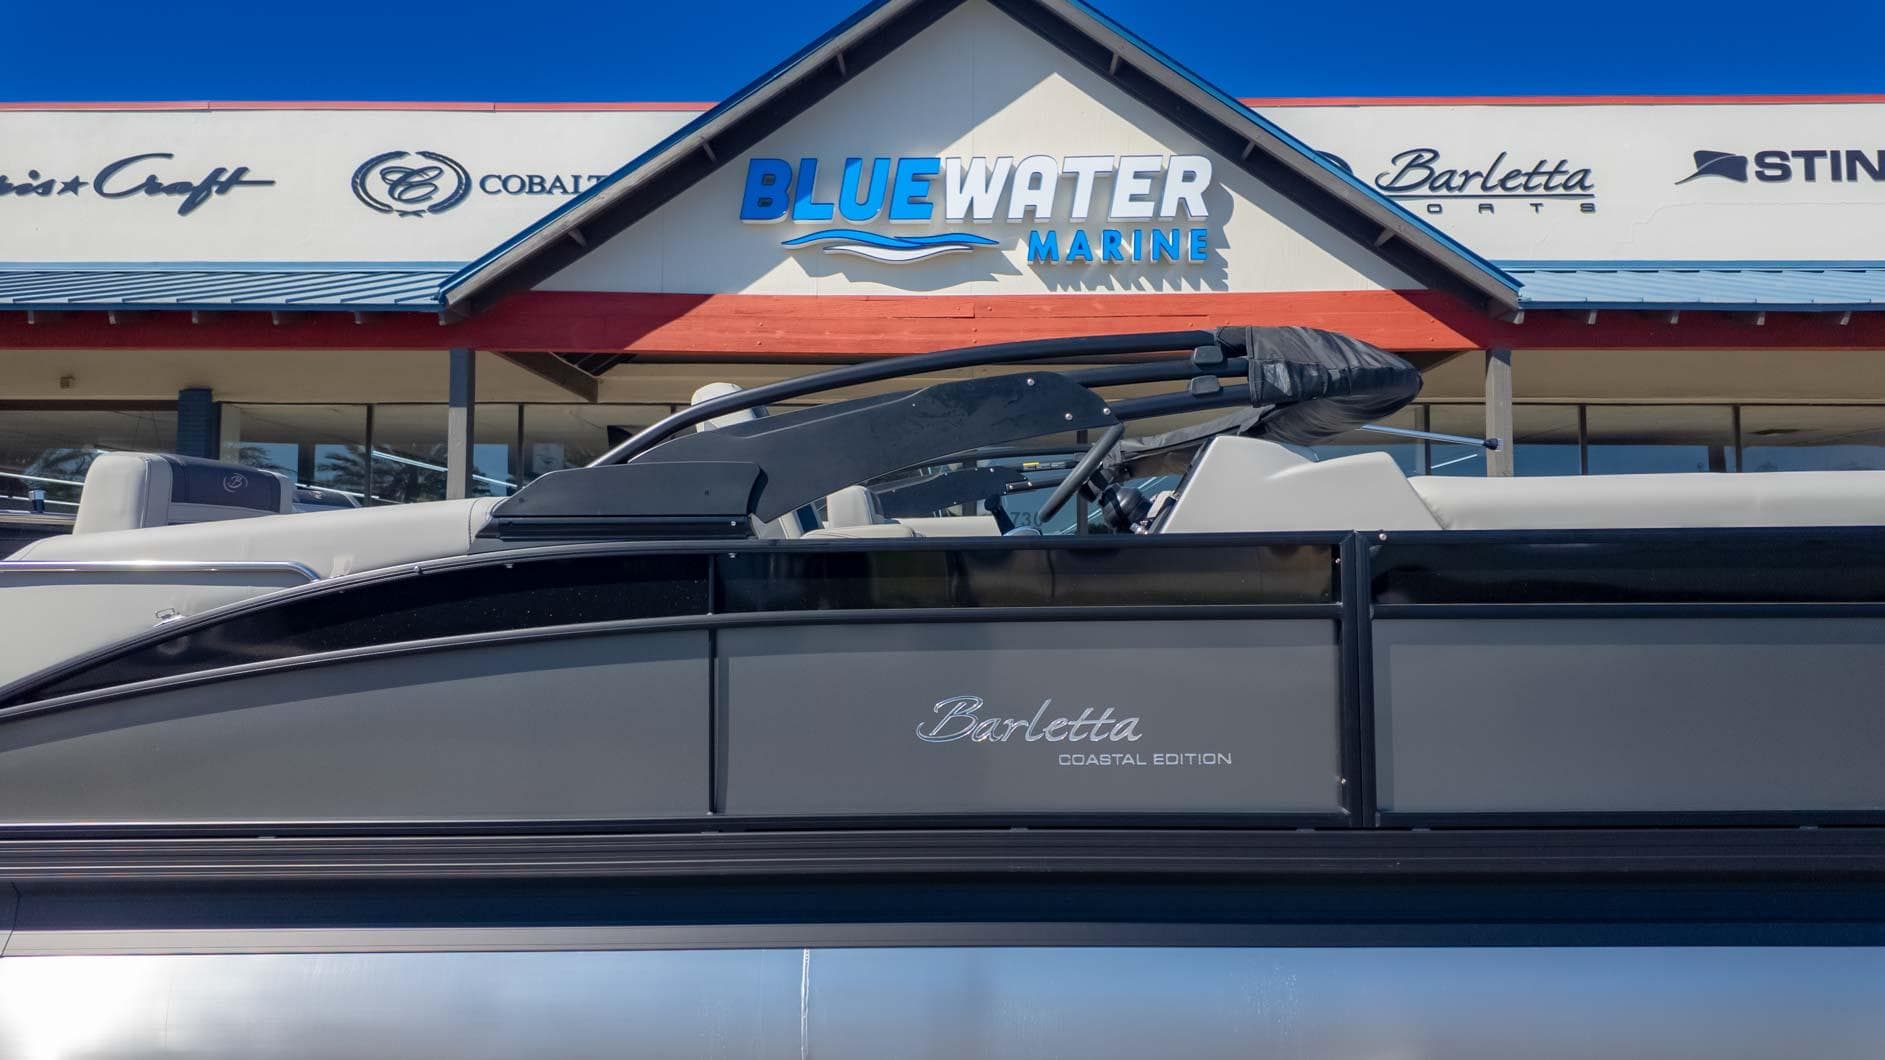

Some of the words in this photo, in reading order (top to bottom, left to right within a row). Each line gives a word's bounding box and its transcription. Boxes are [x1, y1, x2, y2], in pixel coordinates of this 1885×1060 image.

[93, 152, 276, 217] Craft
[1375, 147, 1595, 193] Barletta
[1754, 149, 1885, 183] STIN
[739, 154, 1213, 225] BLUEWATER
[1027, 228, 1209, 264] MARINE
[916, 695, 1143, 743] Barletta
[1057, 752, 1148, 766] COASTAL
[1152, 752, 1233, 766] EDITION
